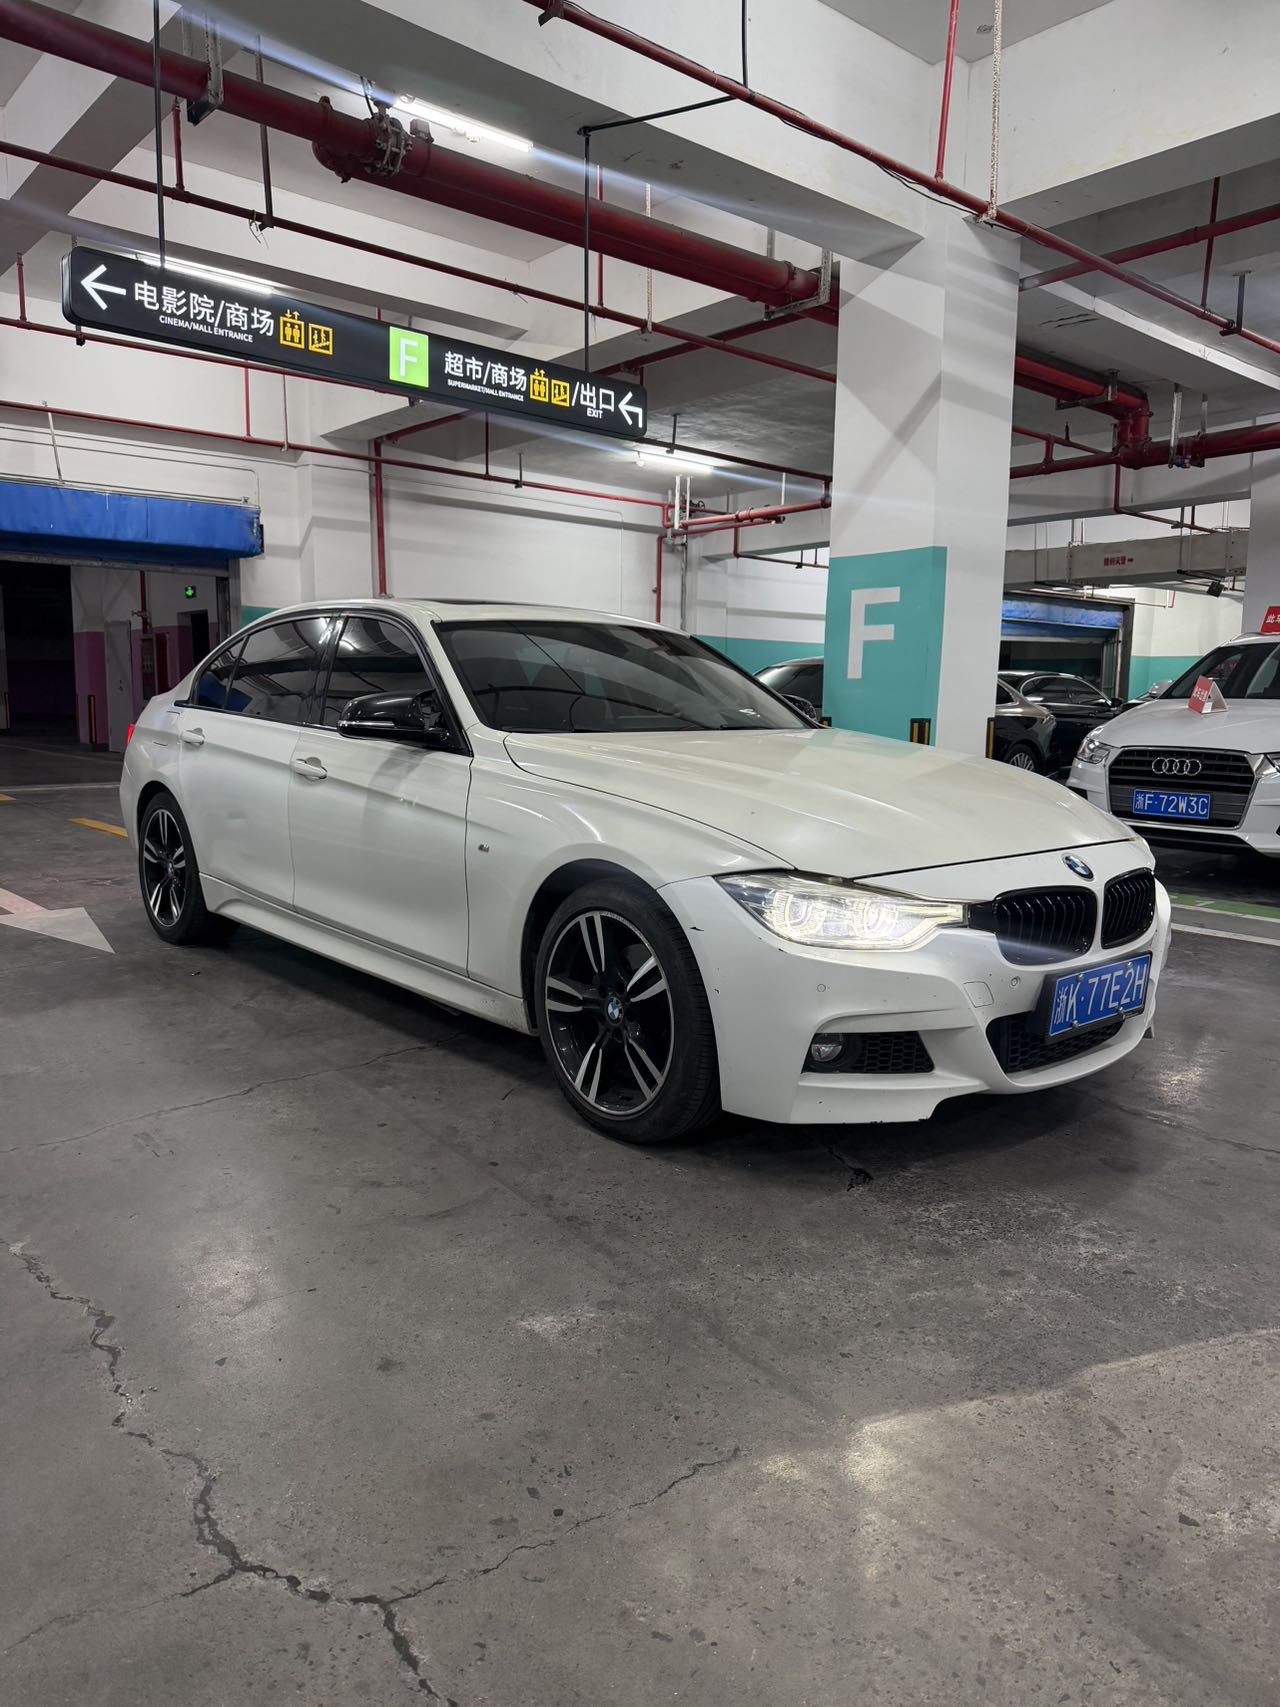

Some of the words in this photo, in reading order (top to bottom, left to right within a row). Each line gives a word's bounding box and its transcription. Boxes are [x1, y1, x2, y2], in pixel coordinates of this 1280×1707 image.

[134, 280, 275, 337] 电影院/商场
[159, 315, 213, 334] CINEMA/MALL
[213, 327, 254, 343] ENTRANCE
[399, 337, 418, 377] F
[444, 351, 527, 392] 超市/商场
[447, 378, 499, 397] SUPERMARKET/MALL
[498, 389, 525, 402] ENTRANCE
[586, 407, 603, 419] EXIT
[847, 586, 901, 679] F
